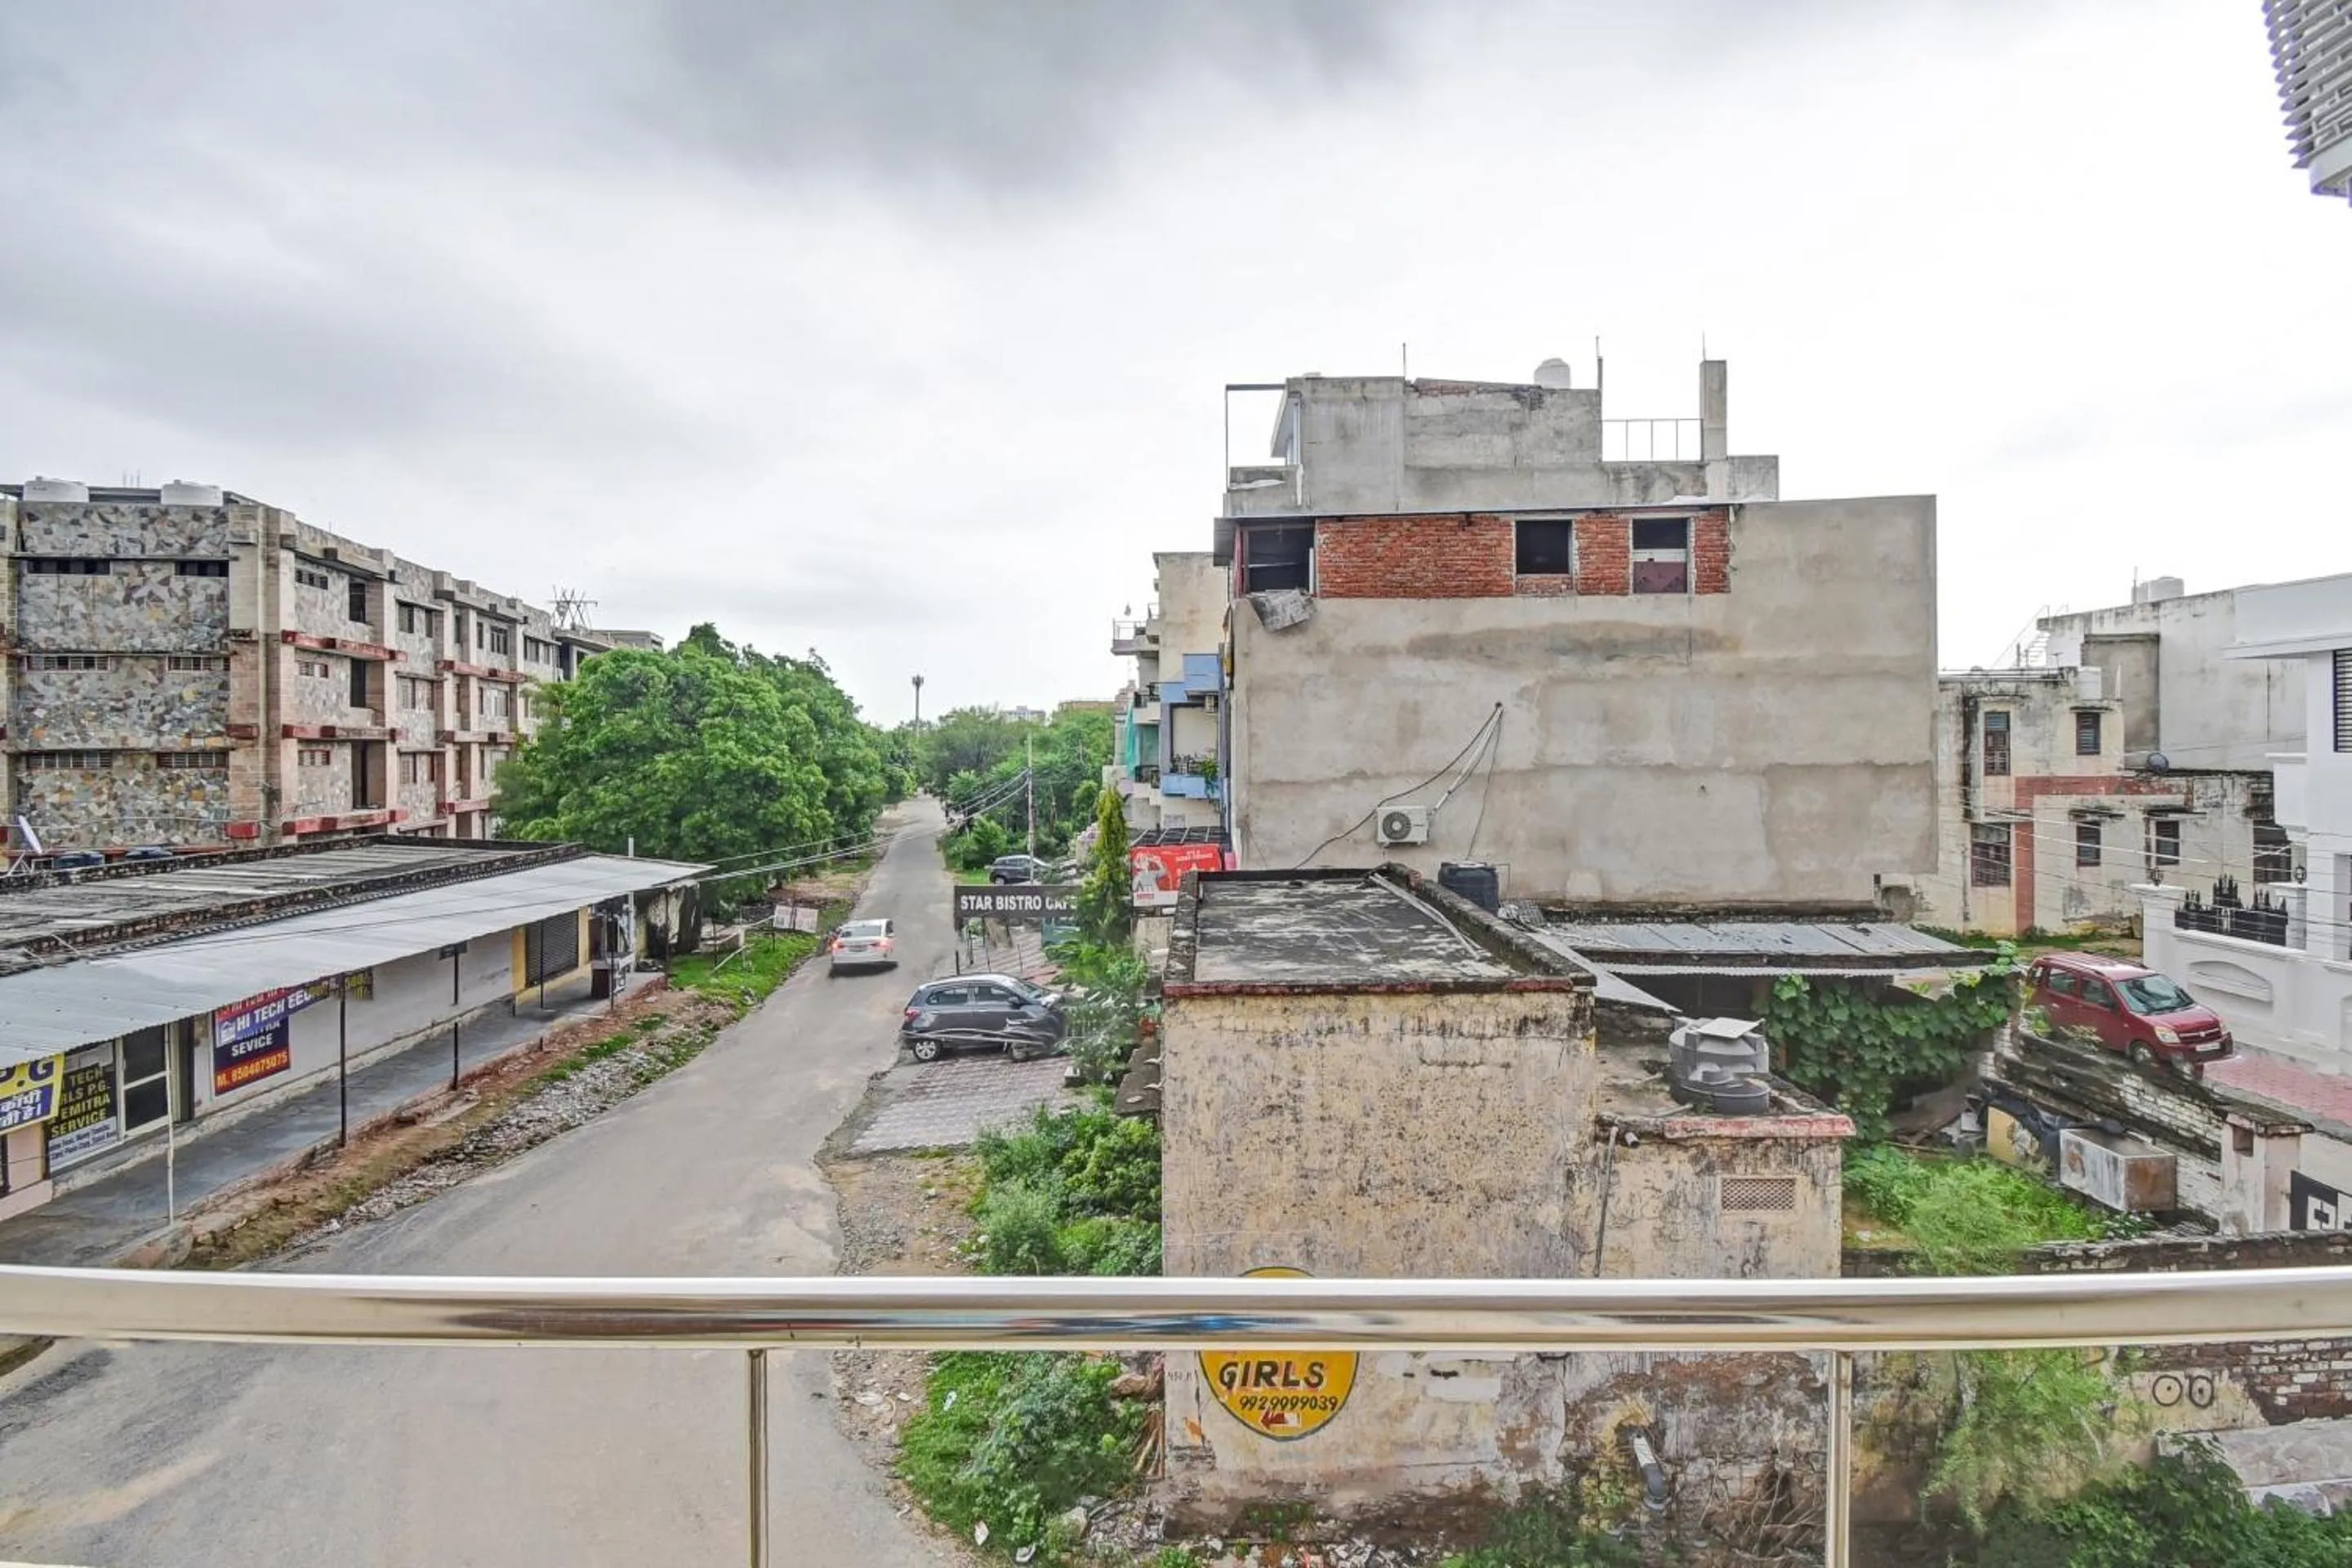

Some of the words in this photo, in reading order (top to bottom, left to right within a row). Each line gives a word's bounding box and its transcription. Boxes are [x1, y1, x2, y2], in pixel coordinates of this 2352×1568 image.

[960, 895, 992, 910] STAR
[996, 895, 1041, 910] BISTRO
[237, 1014, 250, 1031] HI
[254, 998, 285, 1024] TECH
[231, 1032, 274, 1058] SEVICE
[61, 1094, 111, 1118] EMITRA
[51, 1107, 107, 1136] SERVICE
[1218, 1360, 1325, 1391] GIRLS
[1240, 1394, 1339, 1412] 9929999039
